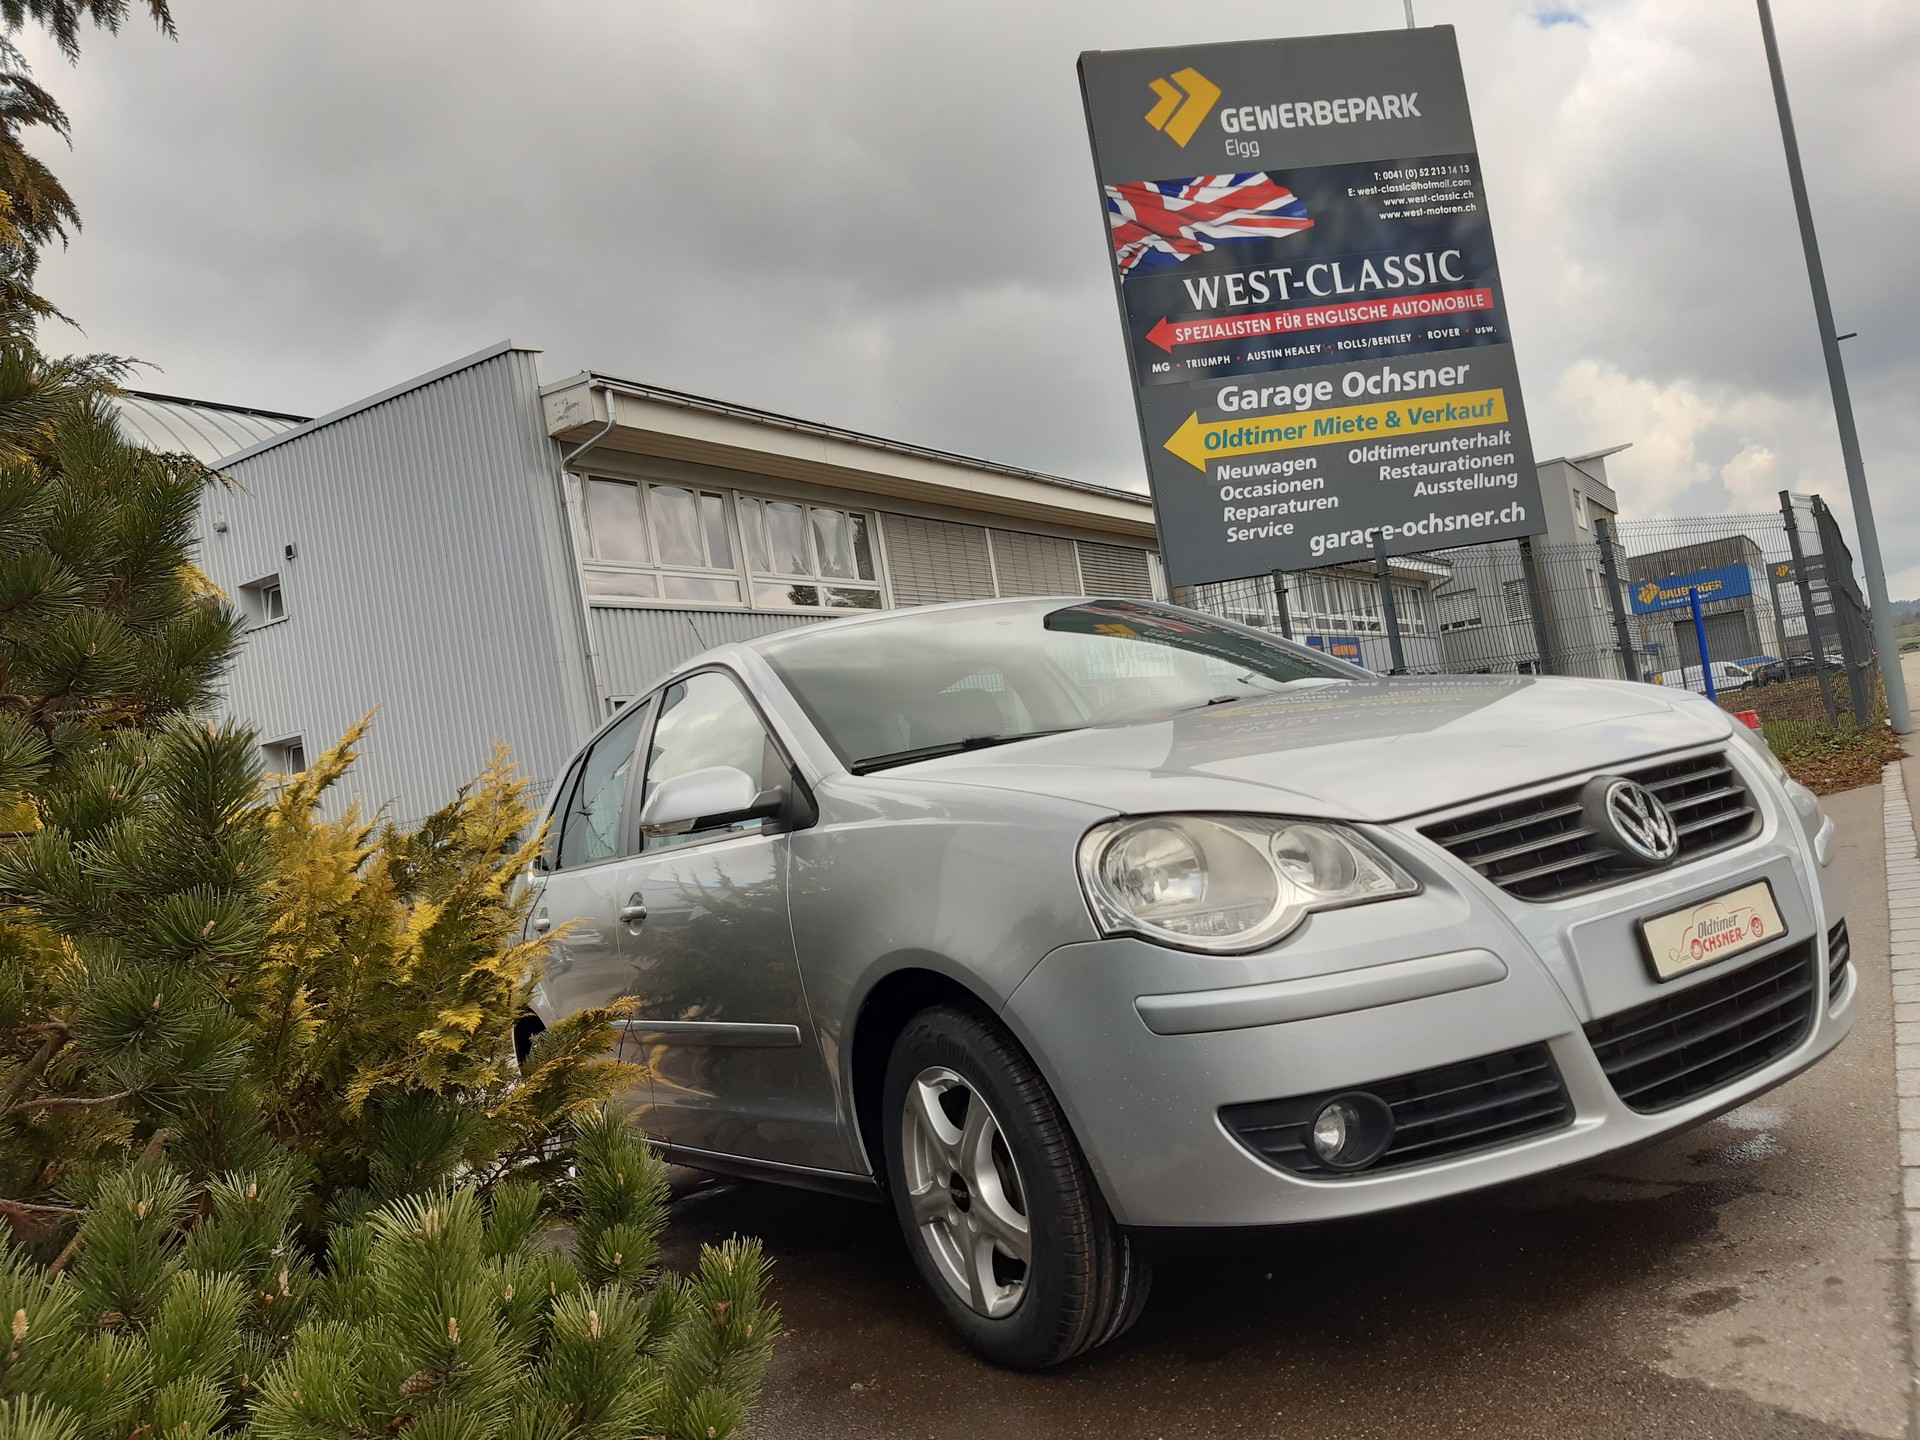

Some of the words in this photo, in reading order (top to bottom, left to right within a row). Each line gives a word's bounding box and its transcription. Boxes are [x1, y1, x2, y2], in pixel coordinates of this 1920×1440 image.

[1220, 92, 1422, 133] GEWERBEPARK
[1225, 138, 1261, 158] Elgg
[1374, 172, 1382, 181] T:
[1383, 170, 1403, 180] 0041
[1405, 168, 1418, 180] (0)
[1419, 168, 1430, 177] 52
[1431, 166, 1447, 176] 213
[1449, 165, 1458, 175] 14
[1459, 165, 1470, 174] 13
[1347, 188, 1356, 197] E:
[1357, 178, 1472, 196] west-classic@hotmail.com
[1383, 190, 1475, 206] www.west-classic.ch
[1379, 203, 1477, 220] www.west-motoren.ch
[1183, 249, 1466, 312] WEST-CLASSIC
[1176, 318, 1272, 342] SPEZIALISTEN
[1276, 313, 1302, 330] FÜR
[1306, 304, 1388, 327] ENGLISCHE
[1392, 294, 1485, 317] AUTOMOBILE
[1151, 362, 1171, 374] MG
[1186, 355, 1231, 369] TRIUMPH
[1246, 348, 1283, 362] AUSTIN
[1284, 344, 1322, 356] HEALEY
[1337, 333, 1412, 351] ROLLS/BENTLEY
[1427, 327, 1461, 340] ROVER
[1216, 380, 1333, 412] Garage
[1342, 364, 1470, 397] Ochsner
[1203, 422, 1307, 451] Oldtimer
[1313, 415, 1379, 436] Miete
[1385, 410, 1401, 428] &
[1408, 397, 1495, 425] Verkauf
[1348, 430, 1511, 465] Oldtimerunterhalt
[1217, 457, 1317, 481] Neuwagen
[1379, 452, 1515, 482] Restaurationen
[1220, 477, 1325, 502] Occasionen
[1413, 472, 1518, 498] Ausstellung
[1223, 495, 1339, 523] Reparaturen
[1226, 521, 1295, 543] Service
[1697, 915, 1738, 938] Oldtimer
[1690, 926, 1743, 960] OCHSNER
